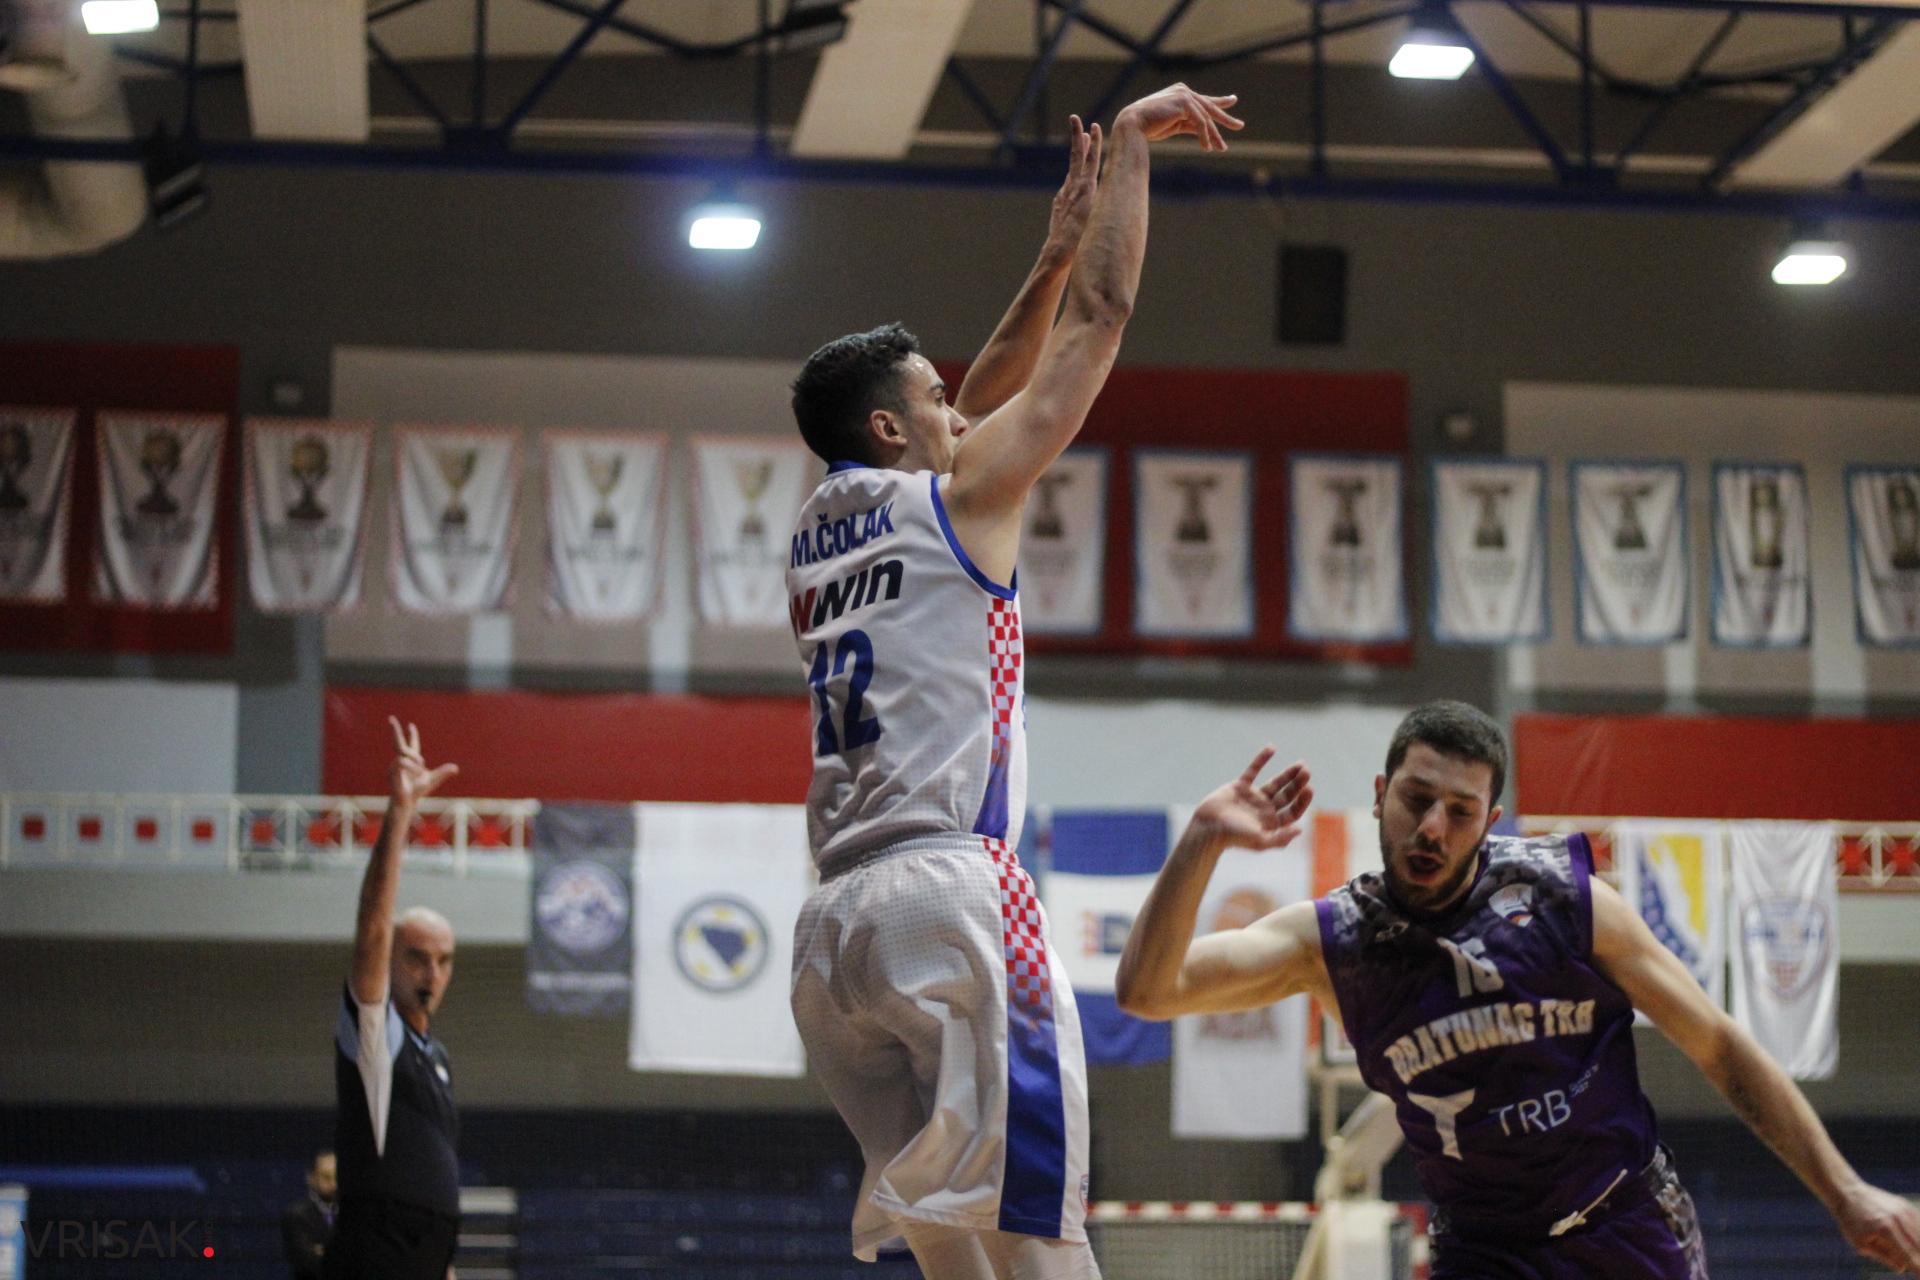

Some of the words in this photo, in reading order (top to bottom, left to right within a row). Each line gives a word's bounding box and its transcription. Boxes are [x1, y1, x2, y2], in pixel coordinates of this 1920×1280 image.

[791, 502, 895, 569] M.ČOLAK
[808, 628, 882, 757] 12
[1488, 1089, 1572, 1137] TRB
